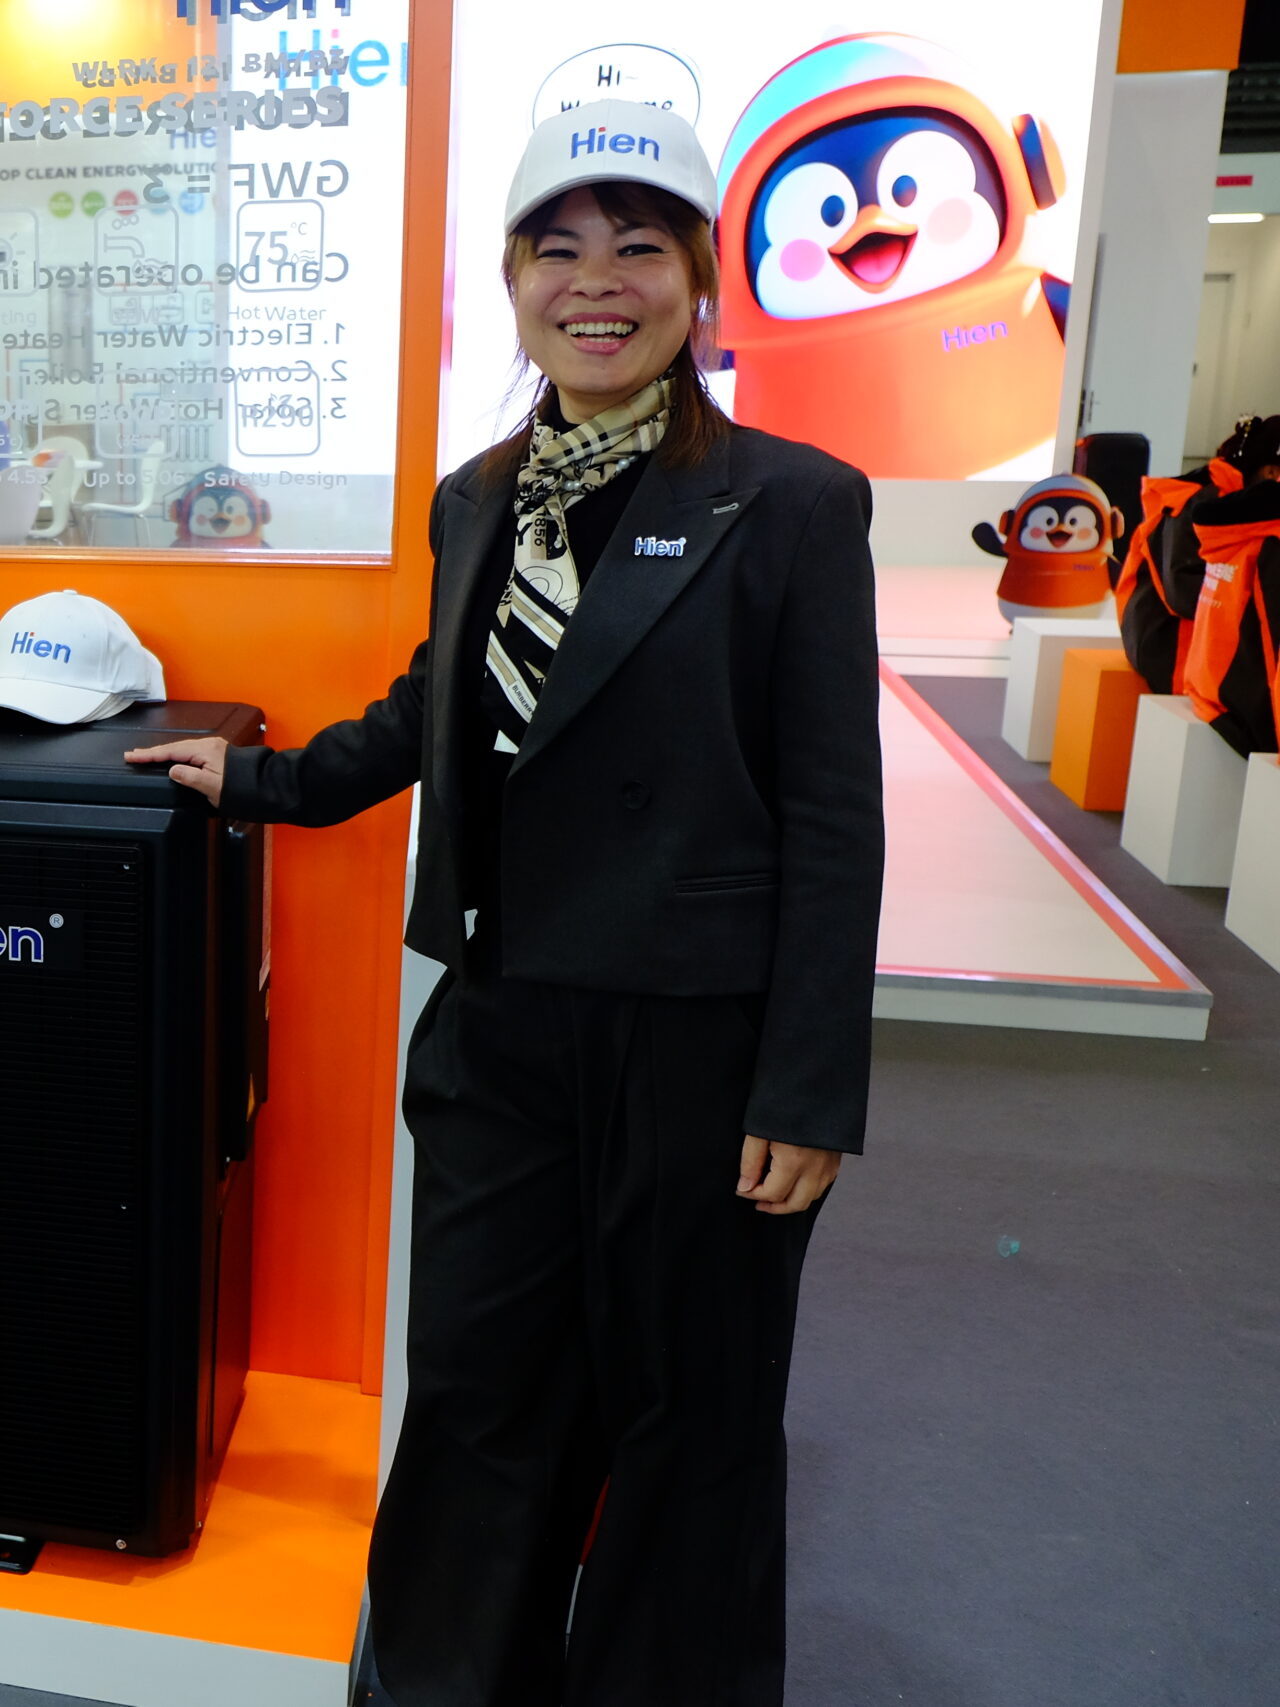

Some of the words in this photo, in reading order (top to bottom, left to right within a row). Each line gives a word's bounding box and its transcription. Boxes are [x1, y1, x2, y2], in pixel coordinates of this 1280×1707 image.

[279, 28, 408, 91] Hie
[158, 85, 345, 131] SERIES
[571, 126, 660, 161] Hien
[25, 167, 77, 181] CLEAN
[244, 230, 289, 266] 75
[265, 306, 328, 321] Water
[941, 319, 1008, 352] Hien
[83, 472, 110, 488] Up
[116, 471, 136, 485] to
[204, 471, 274, 490] Safety
[278, 470, 348, 490] Design
[634, 536, 684, 557] Hien
[10, 631, 72, 664] Hien
[512, 684, 533, 713] BURBERR
